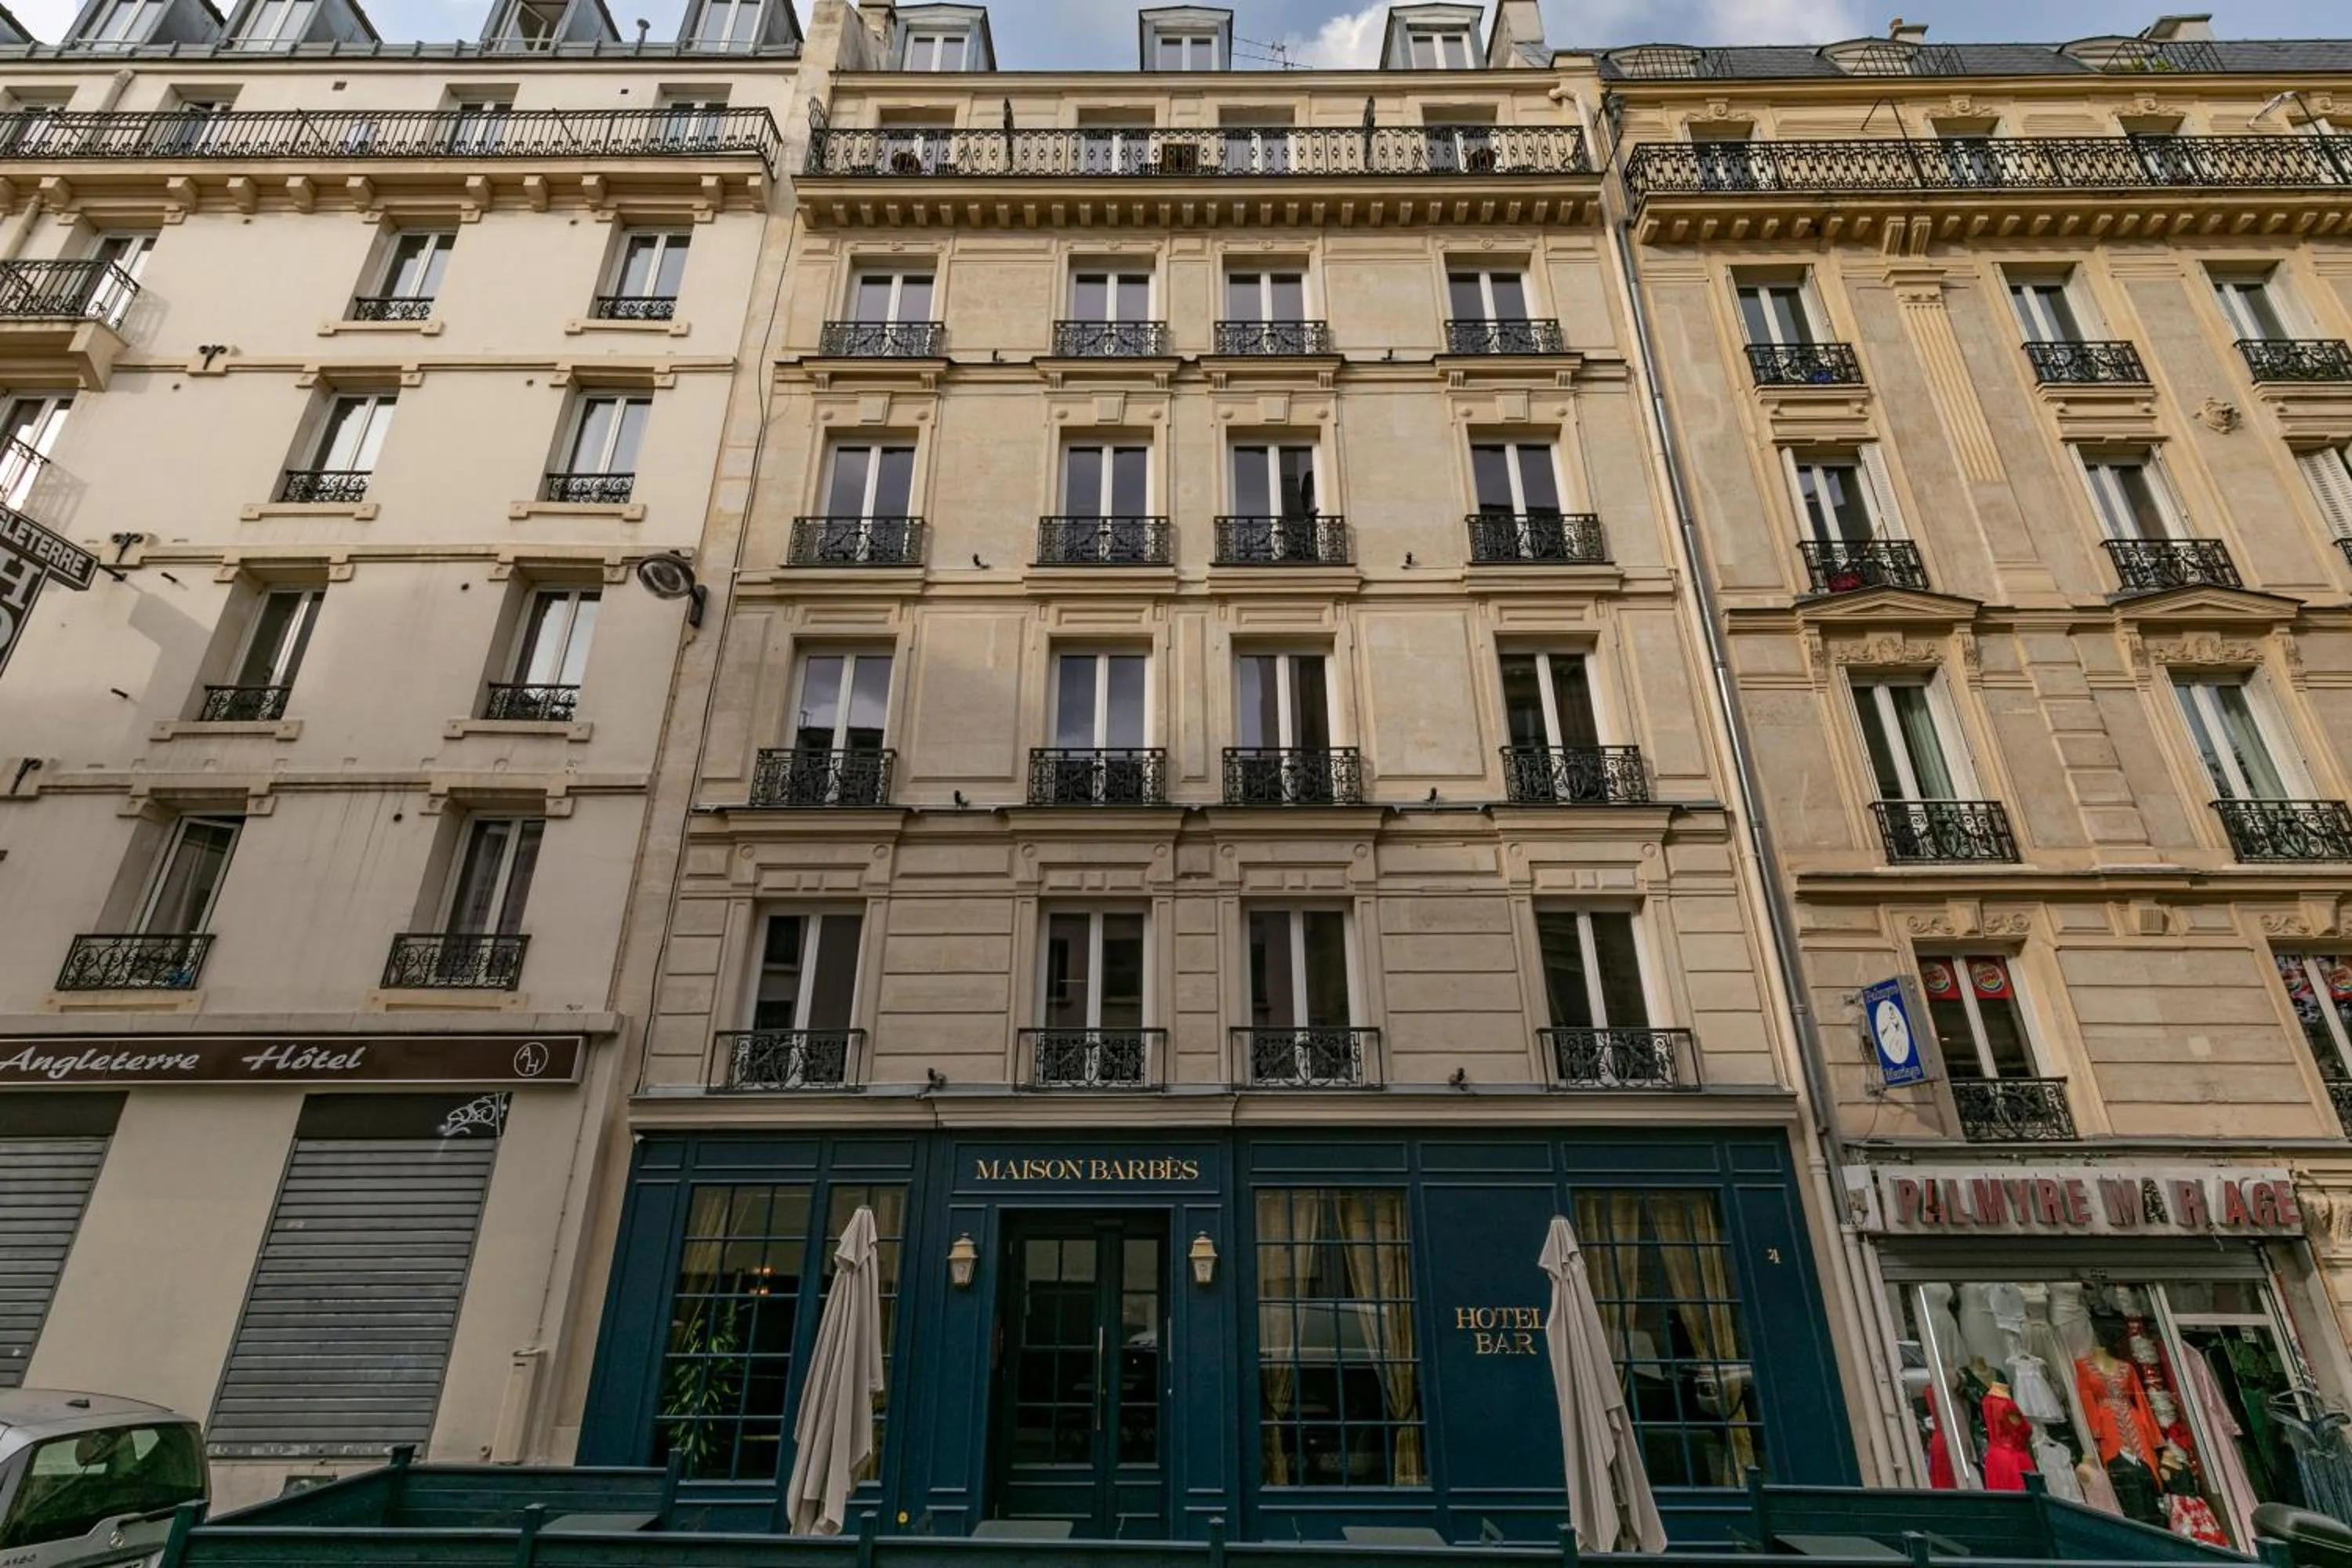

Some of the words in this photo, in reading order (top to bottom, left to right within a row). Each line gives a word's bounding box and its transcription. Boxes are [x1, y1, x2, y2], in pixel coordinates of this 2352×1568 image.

[0, 1046, 201, 1079] Angleterre
[242, 1045, 367, 1071] Hôtel
[975, 1159, 1083, 1180] MAISON
[1089, 1156, 1199, 1180] BARBÈS
[1455, 1307, 1547, 1329] HOTEL
[1475, 1332, 1537, 1355] BAR
